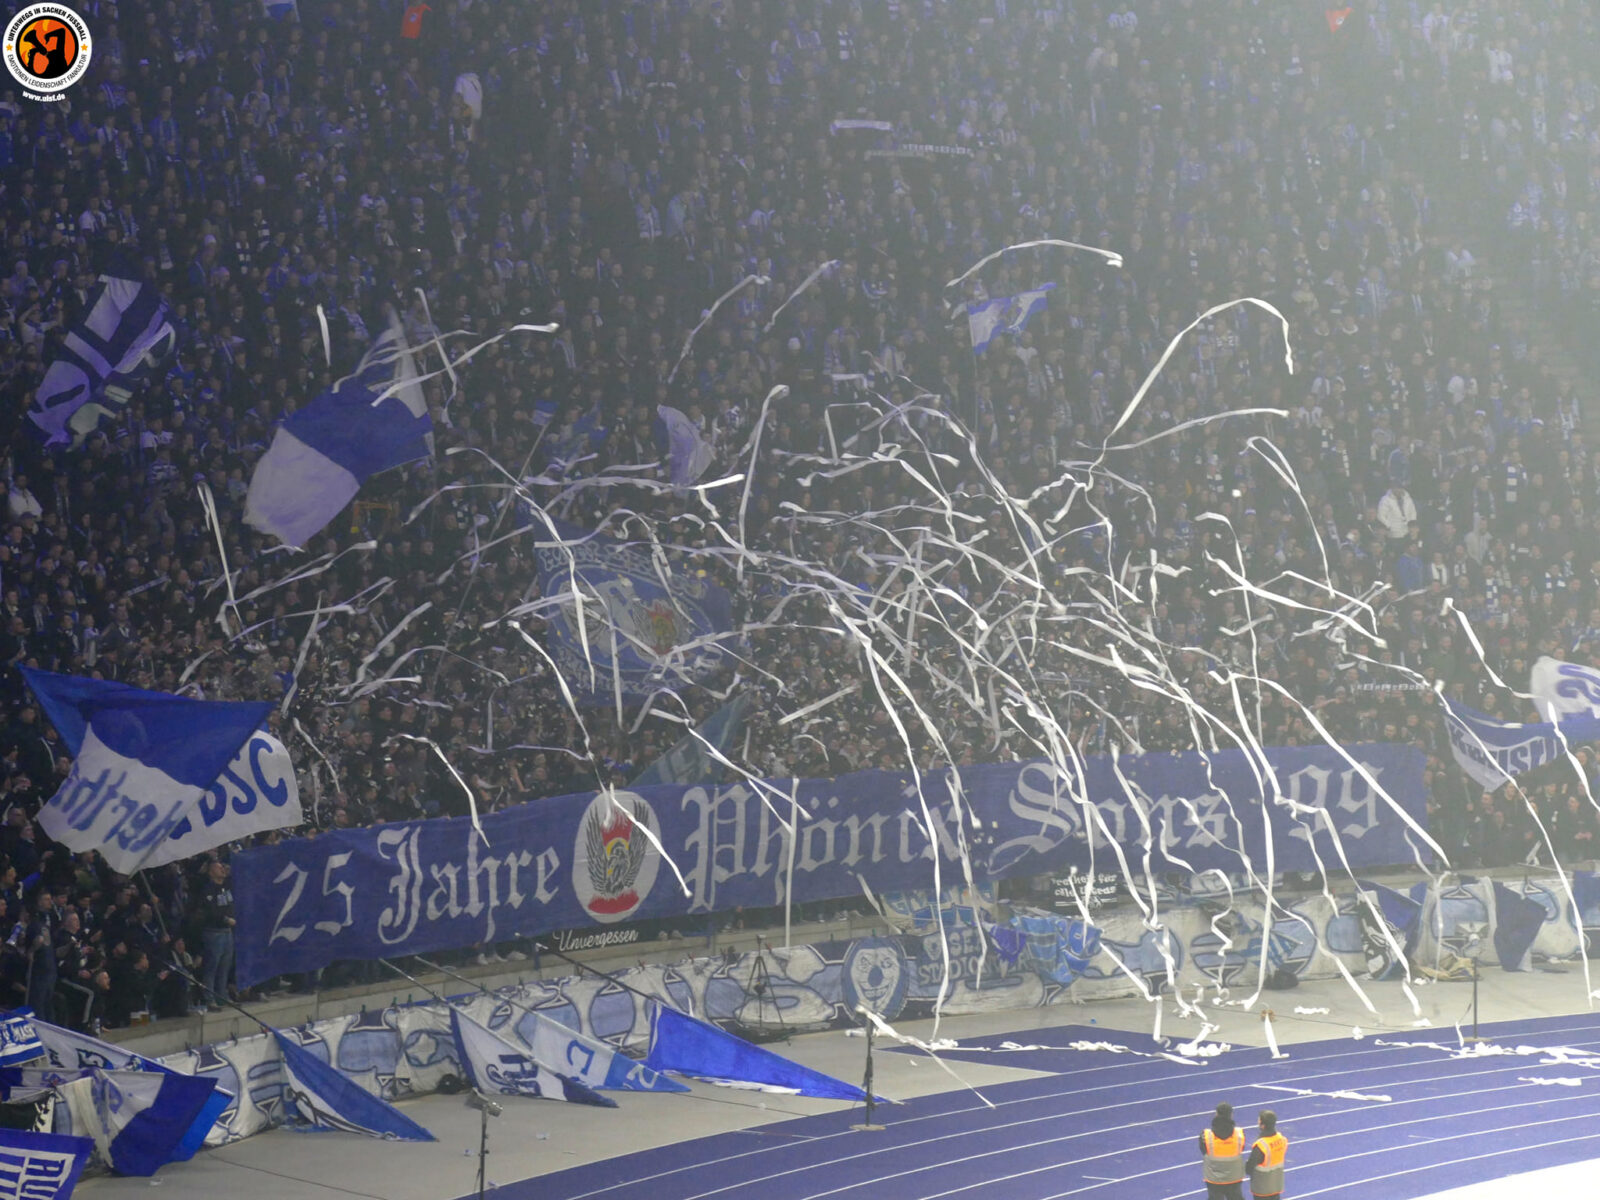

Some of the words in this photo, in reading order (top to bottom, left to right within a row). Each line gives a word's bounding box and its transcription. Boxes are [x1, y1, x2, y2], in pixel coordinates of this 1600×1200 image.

[269, 851, 355, 946] 25
[377, 824, 562, 944] Jahre
[552, 929, 639, 952] Unvergessen
